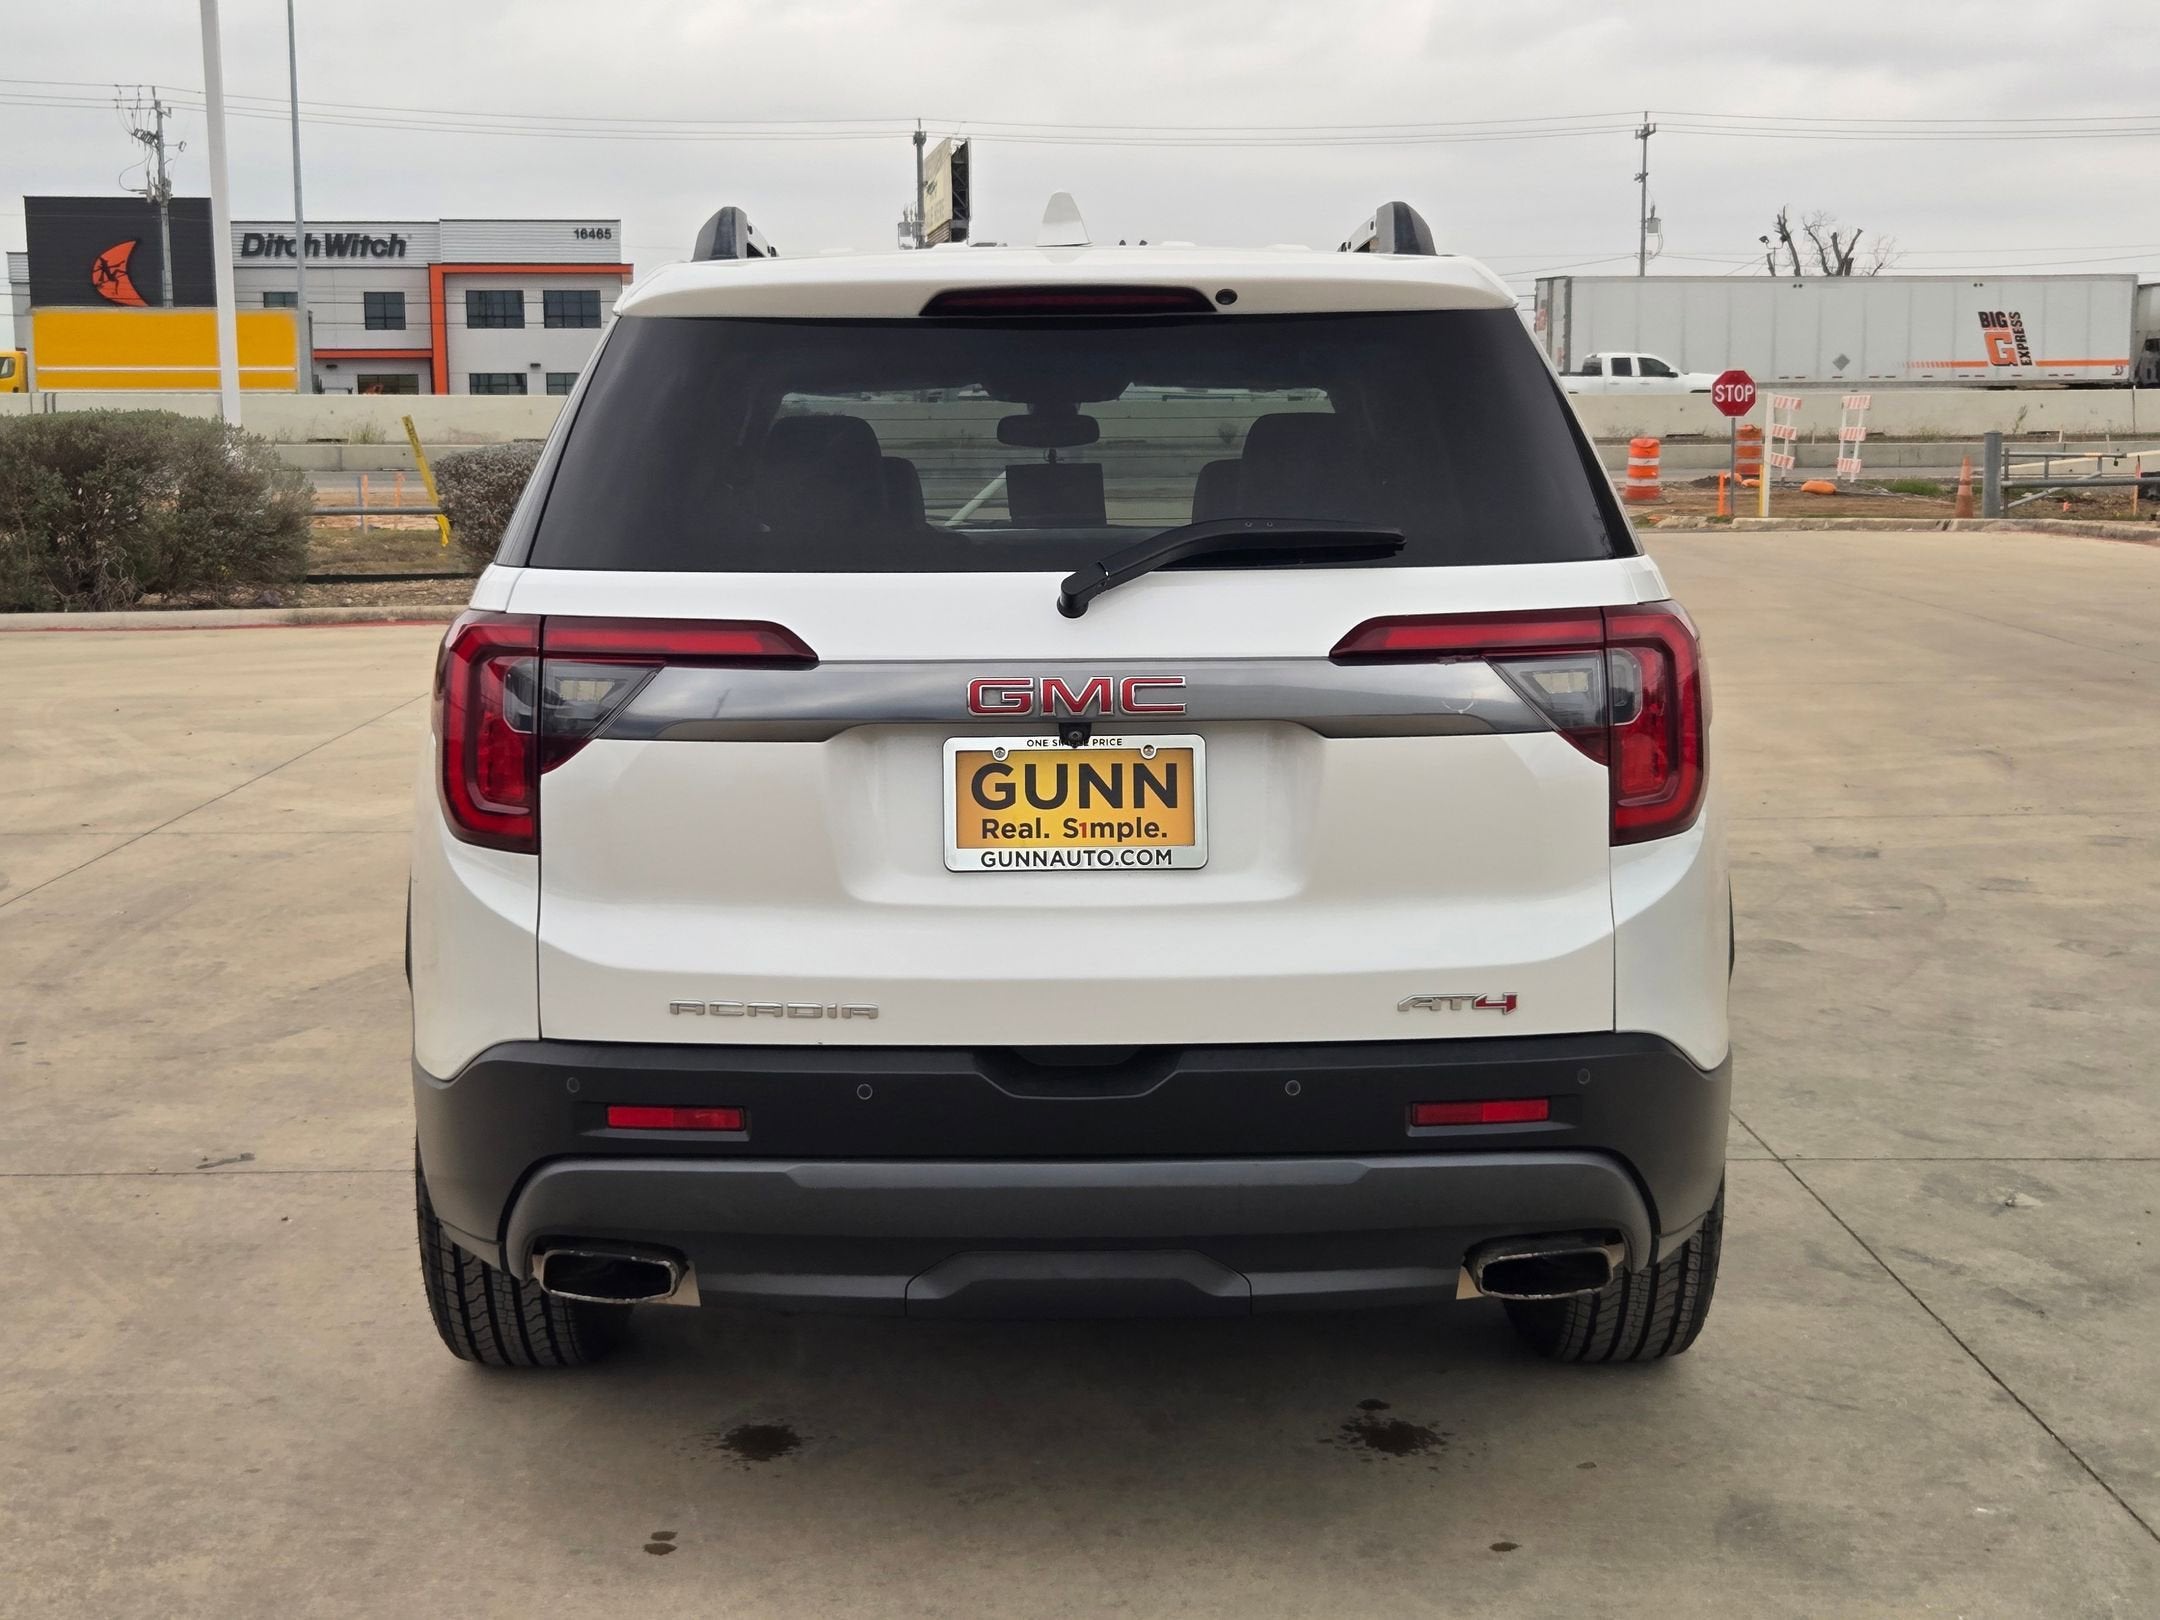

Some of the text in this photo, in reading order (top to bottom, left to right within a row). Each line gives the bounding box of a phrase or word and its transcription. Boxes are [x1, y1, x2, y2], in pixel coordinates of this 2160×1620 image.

[573, 227, 612, 240] 16465
[241, 232, 407, 257] Ditch Witch
[1977, 311, 2009, 328] BIG
[1983, 331, 2019, 367] G
[2008, 311, 2033, 366] EXPRESS
[1714, 384, 1754, 402] STOP
[967, 676, 1187, 717] GMC
[1026, 738, 1049, 747] ONE
[1092, 738, 1123, 747] PRICE
[970, 762, 1178, 810] GUNN
[981, 818, 1050, 839] Real.
[980, 849, 1172, 867] GUNNAUTO.COM
[669, 1000, 879, 1019] ACADIA
[1397, 992, 1517, 1015] AT4
